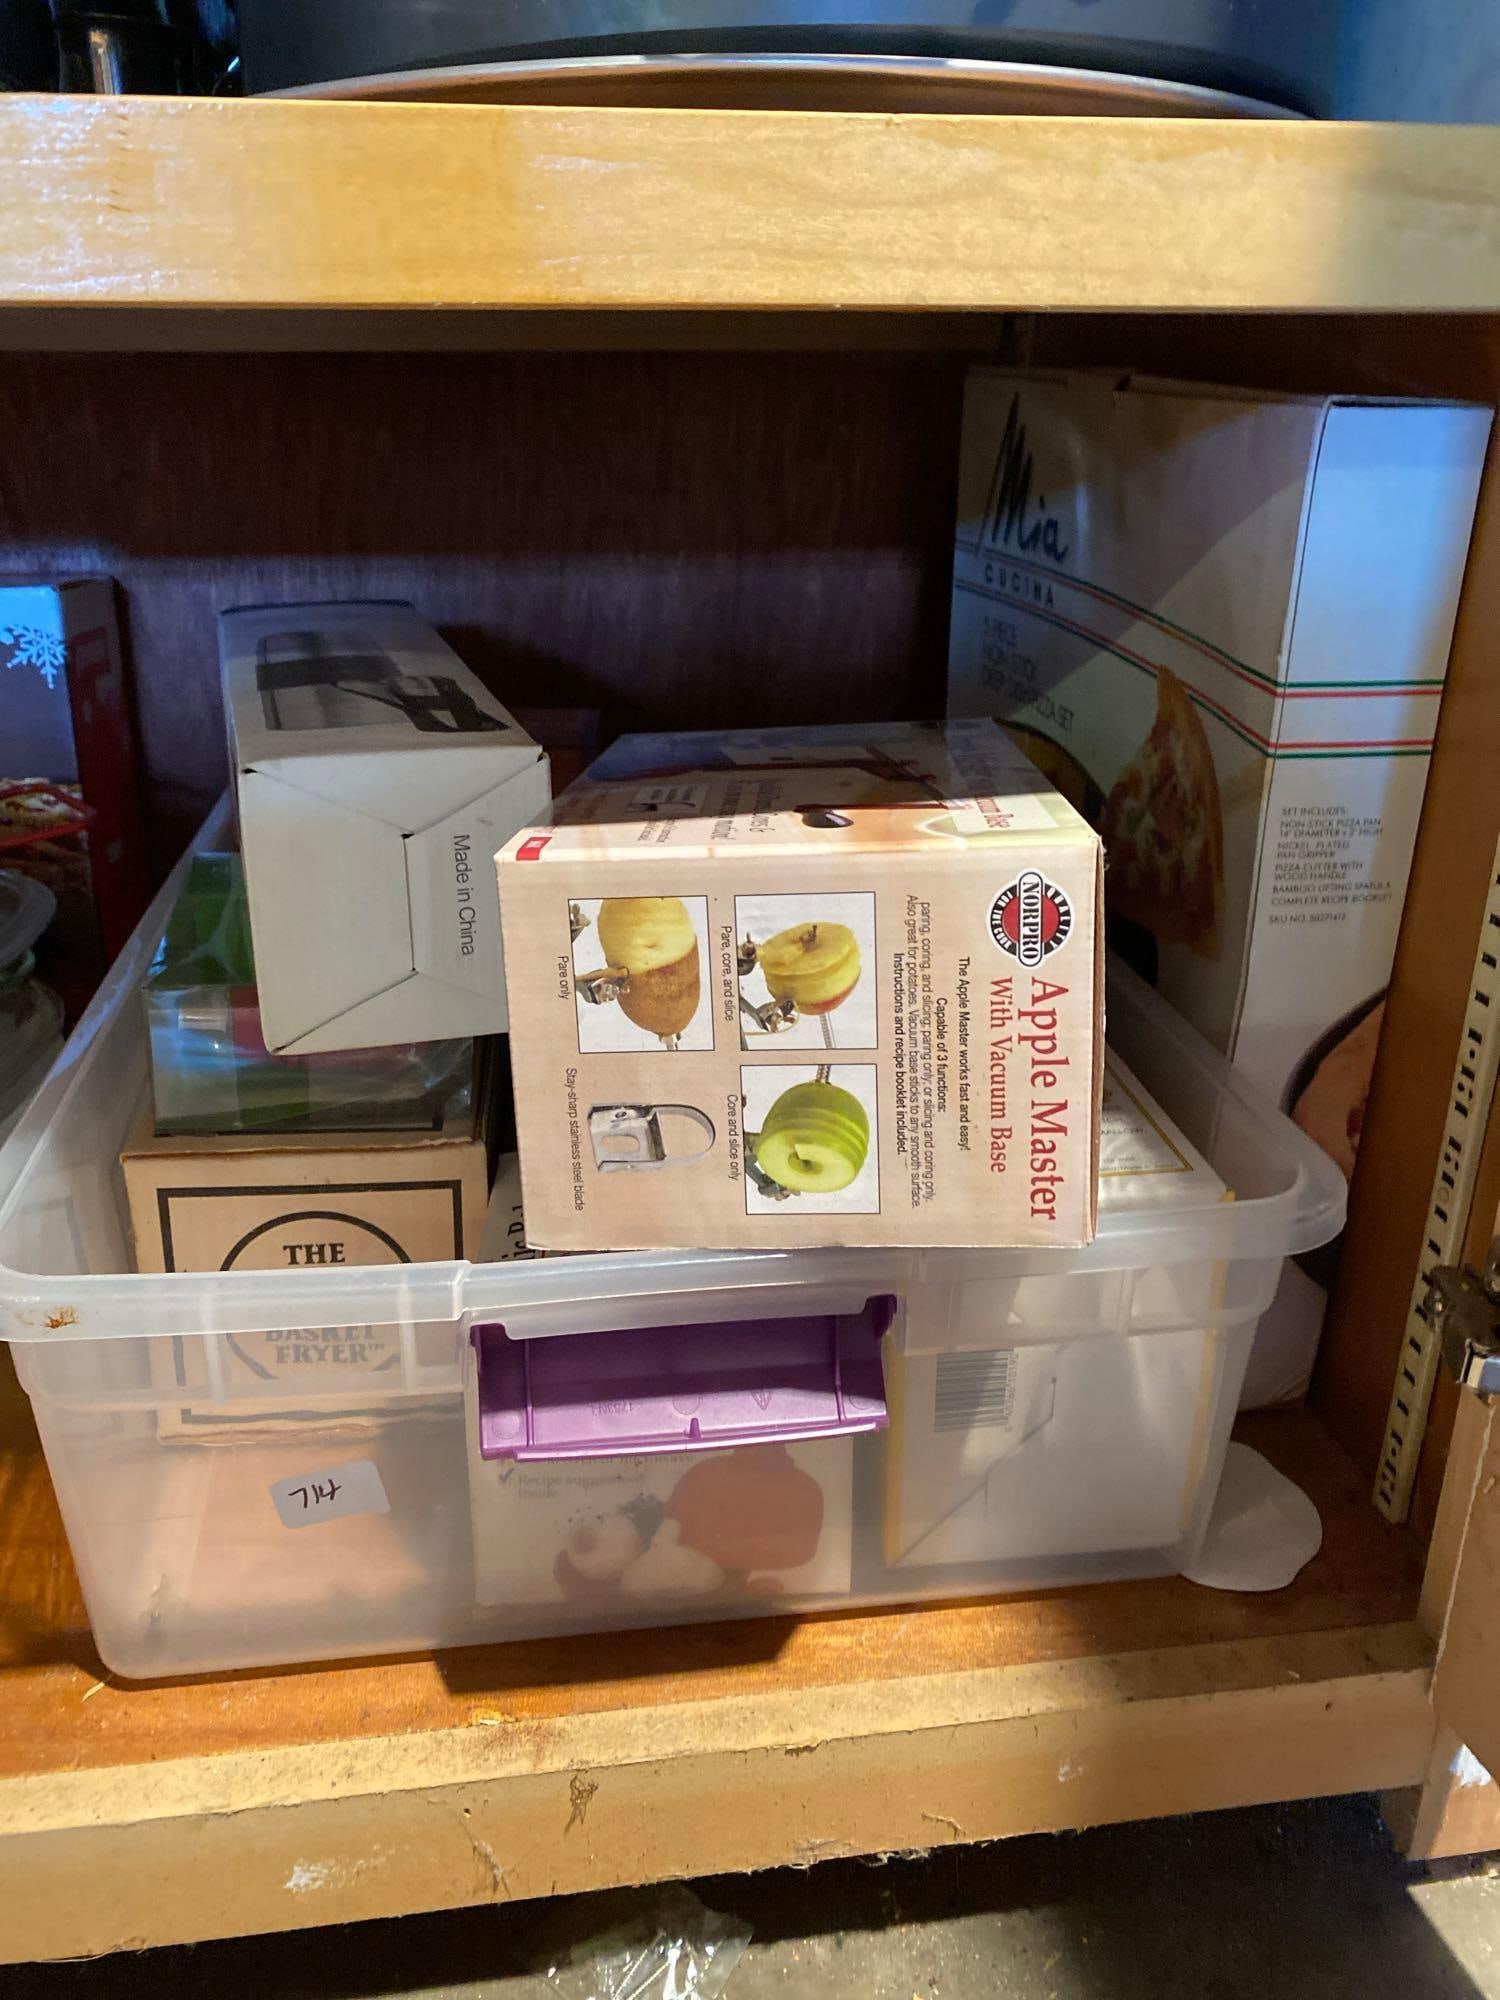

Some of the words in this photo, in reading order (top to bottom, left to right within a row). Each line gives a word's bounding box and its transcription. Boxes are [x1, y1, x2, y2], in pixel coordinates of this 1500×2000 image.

[976, 391, 1069, 563] Mia
[984, 563, 1054, 608] CUCINA
[984, 812, 1014, 828] Base
[1336, 818, 1360, 827] PIZZA
[453, 834, 472, 883] Made
[1275, 862, 1300, 871] PIZZA
[1340, 860, 1363, 870] WITH
[457, 887, 474, 902] in
[906, 895, 919, 917] Also
[996, 890, 1014, 908] FOR
[991, 909, 1002, 925] THE
[1022, 881, 1040, 959] NORPRO
[1046, 886, 1071, 949] QUALITY
[459, 906, 476, 955] China
[721, 926, 732, 951] Pare,
[905, 919, 919, 944] great
[993, 927, 1013, 950] COOK
[722, 953, 732, 977] core,
[908, 946, 920, 960] for
[558, 956, 569, 978] Pare
[958, 956, 970, 976] The
[558, 980, 571, 1000] only
[723, 979, 735, 998] and
[894, 953, 905, 1013] Instructions
[922, 974, 933, 993] and
[956, 978, 970, 1009] Apple
[724, 1000, 736, 1021] slice
[990, 976, 1013, 1029] With
[895, 1016, 906, 1035] and
[908, 1010, 920, 1048] Vacuum
[934, 997, 948, 1039] Capable
[958, 1010, 970, 1047] Master
[1017, 976, 1070, 1088] Apple
[893, 1037, 906, 1069] recipe
[920, 1030, 932, 1060] paring
[937, 1042, 948, 1053] of
[909, 1051, 920, 1073] base
[959, 1048, 971, 1081] works
[896, 1071, 907, 1109] booklet
[910, 1076, 921, 1103] sticks
[937, 1063, 948, 1112] functions:
[990, 1035, 1013, 1120] Vacuum
[565, 1068, 578, 1118] Stay-sharp
[923, 1086, 932, 1097] or
[960, 1081, 971, 1102] fast
[727, 1094, 738, 1117] Core
[910, 1105, 920, 1115] to
[921, 1099, 934, 1128] slicing
[960, 1102, 971, 1127] and
[728, 1119, 739, 1136] and
[896, 1110, 908, 1155] included.
[908, 1117, 919, 1134] any
[569, 1120, 581, 1160] stainless
[729, 1139, 740, 1159] slice
[924, 1130, 935, 1148] and
[957, 1128, 971, 1151] easy!
[990, 1125, 1013, 1173] Base
[911, 1136, 922, 1170] smooth
[922, 1150, 935, 1178] coring
[1029, 1099, 1068, 1221] Master
[572, 1161, 583, 1183] steel
[728, 1161, 741, 1181] only
[573, 1185, 585, 1211] blade
[282, 1242, 346, 1266] THE
[288, 1478, 342, 1509] 714
